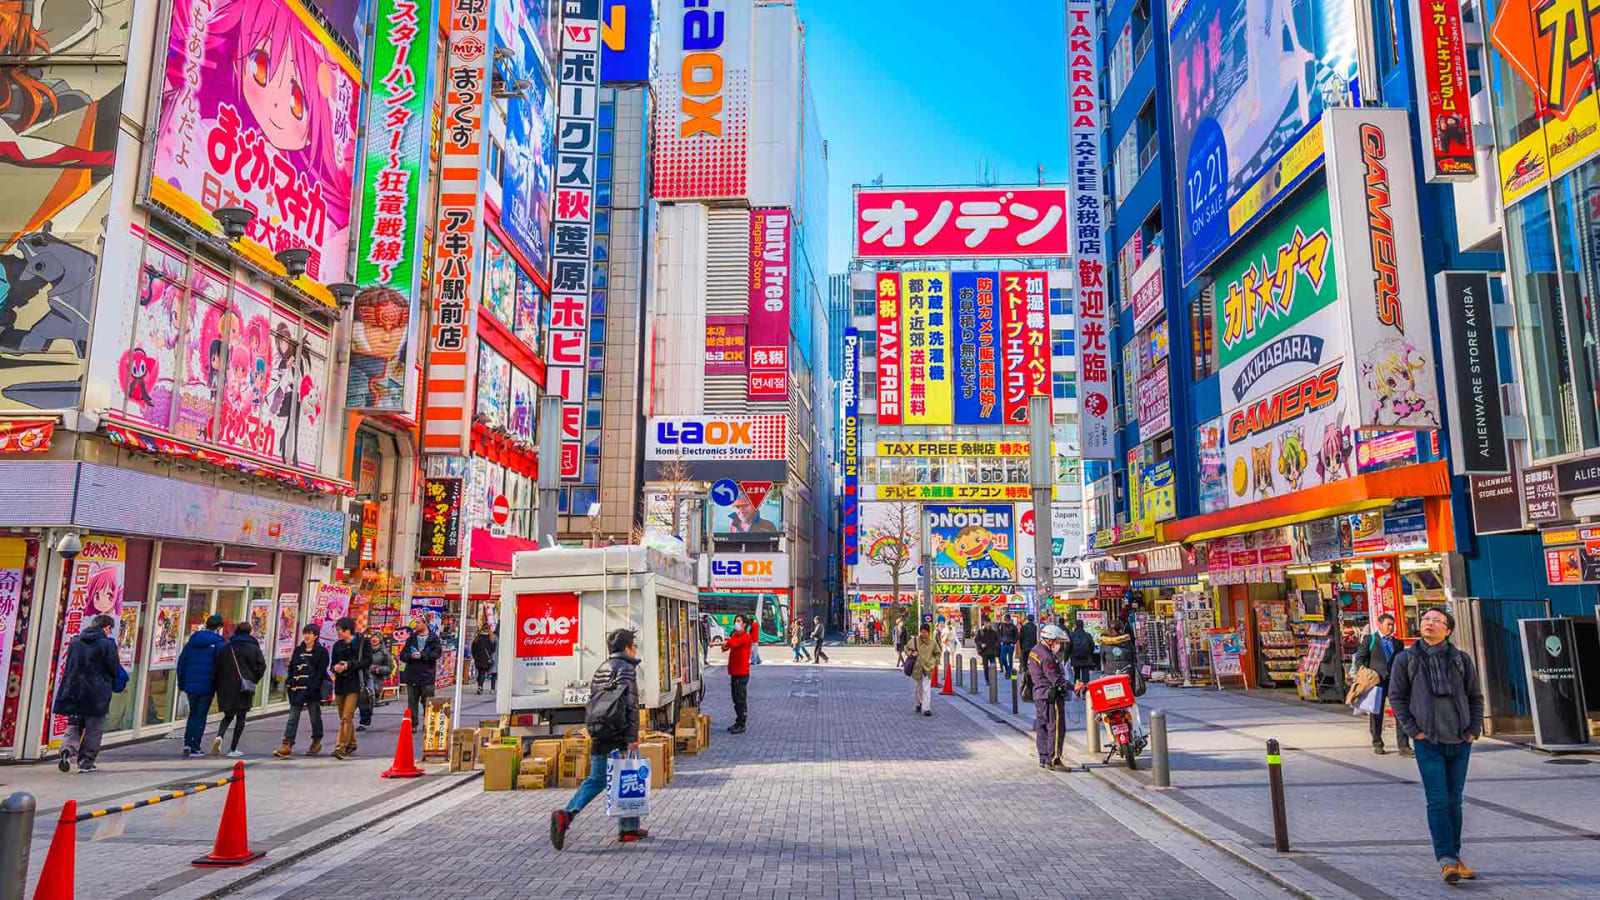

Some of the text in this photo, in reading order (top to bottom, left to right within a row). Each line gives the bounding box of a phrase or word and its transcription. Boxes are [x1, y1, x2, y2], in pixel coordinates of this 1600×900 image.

[1069, 10, 1096, 128] TAKARADA
[1432, 13, 1457, 110] カードキングダム
[452, 67, 478, 149] まっくす
[1188, 145, 1223, 214] 12.21
[753, 214, 764, 290] Flagship Store
[861, 191, 1063, 249] オノデン
[1076, 194, 1100, 254] 免税商店
[1359, 122, 1404, 336] GAMERS
[438, 209, 470, 349] アキバ駅前店
[763, 214, 788, 312] Duty Free
[878, 277, 898, 318] 免税
[927, 278, 945, 381] 冷蔵庫 洗濯機
[753, 350, 785, 365] 免税
[845, 335, 858, 407] Panasonic
[879, 320, 899, 416] TAX FREE
[959, 287, 975, 399] お見積り無料です
[1240, 337, 1312, 389] AKIHABARA
[1462, 286, 1491, 457] ALIENWARE STORE AKIBA
[1229, 362, 1343, 445] GAMERS
[682, 446, 727, 455] Electronics
[729, 446, 753, 455] Store
[846, 416, 857, 476] ONODEN
[885, 443, 914, 455] TAX
[918, 443, 957, 455] FREE
[961, 443, 996, 455] 免税店
[746, 486, 767, 494] 止まれ
[885, 486, 921, 498] テレビ
[958, 486, 1002, 498] エアコン
[1478, 476, 1513, 488] ALIENWARE
[1479, 487, 1514, 499] STORE AKIBA
[930, 512, 1010, 529] ONODEN
[935, 567, 1012, 580] KIHABARA
